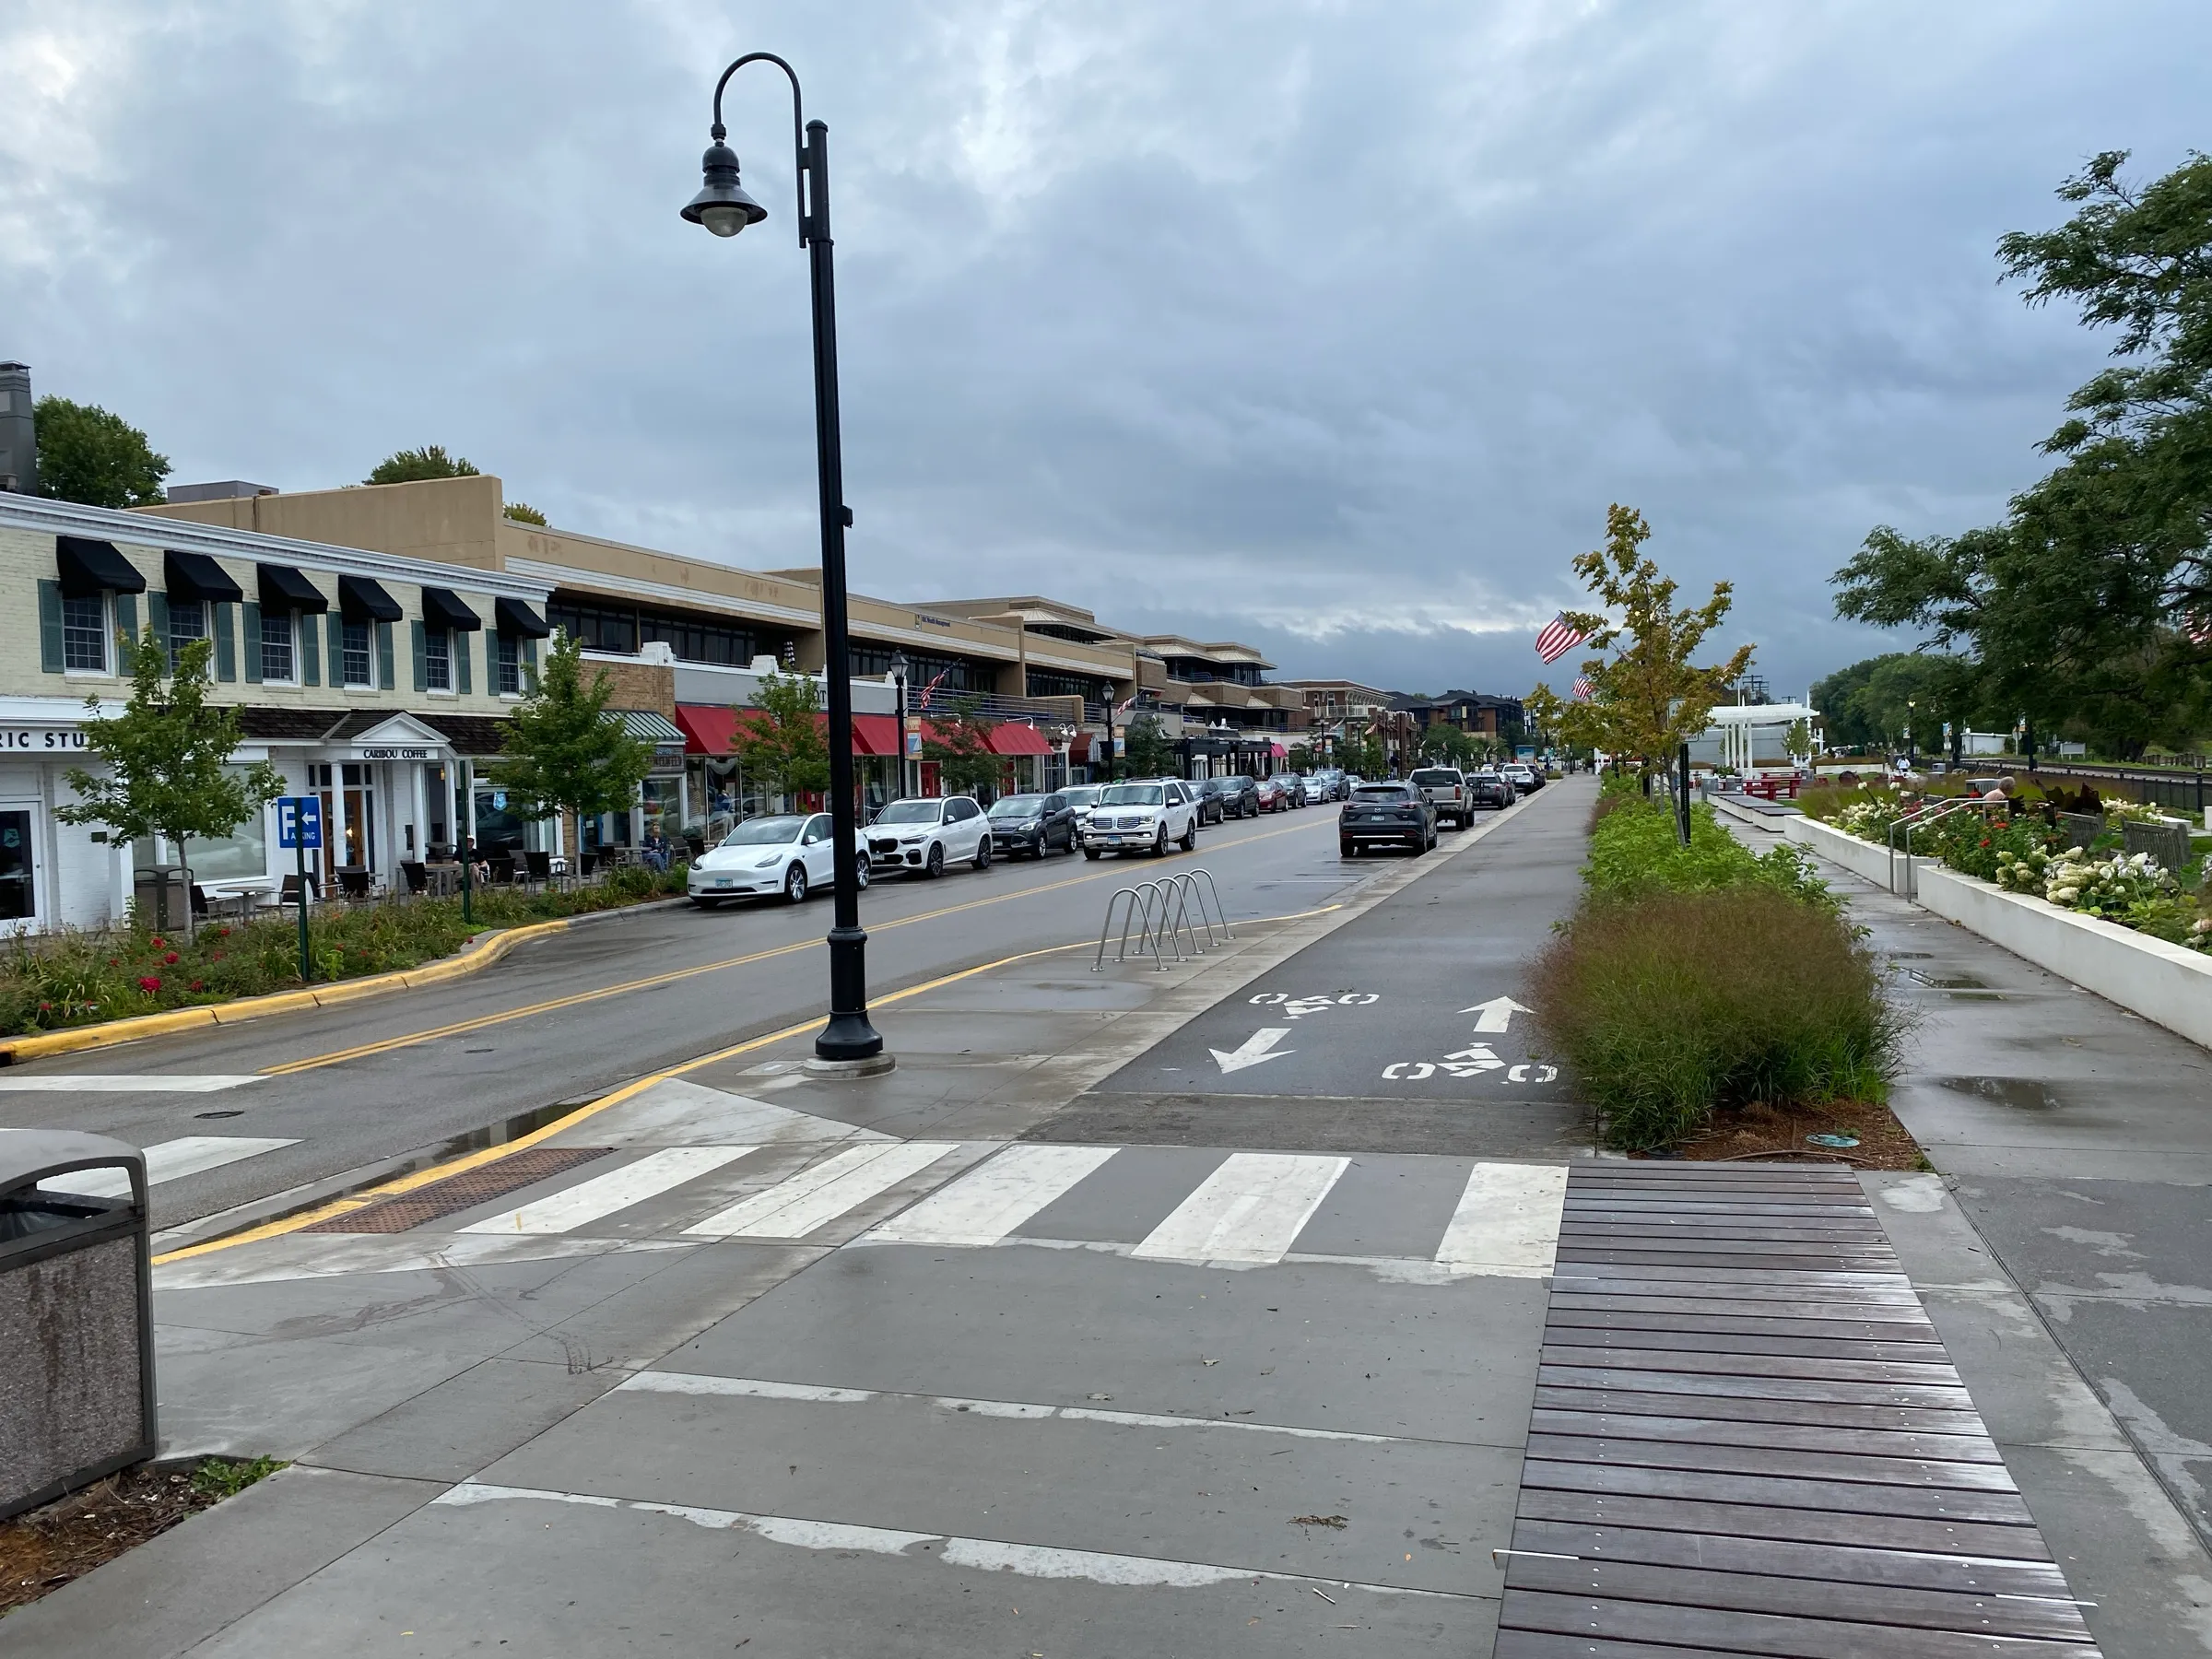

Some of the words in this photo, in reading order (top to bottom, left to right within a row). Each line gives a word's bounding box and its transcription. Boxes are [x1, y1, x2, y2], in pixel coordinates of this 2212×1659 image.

[45, 732, 85, 747] STU
[363, 749, 397, 759] CARIBOU
[402, 749, 427, 759] COFFEE
